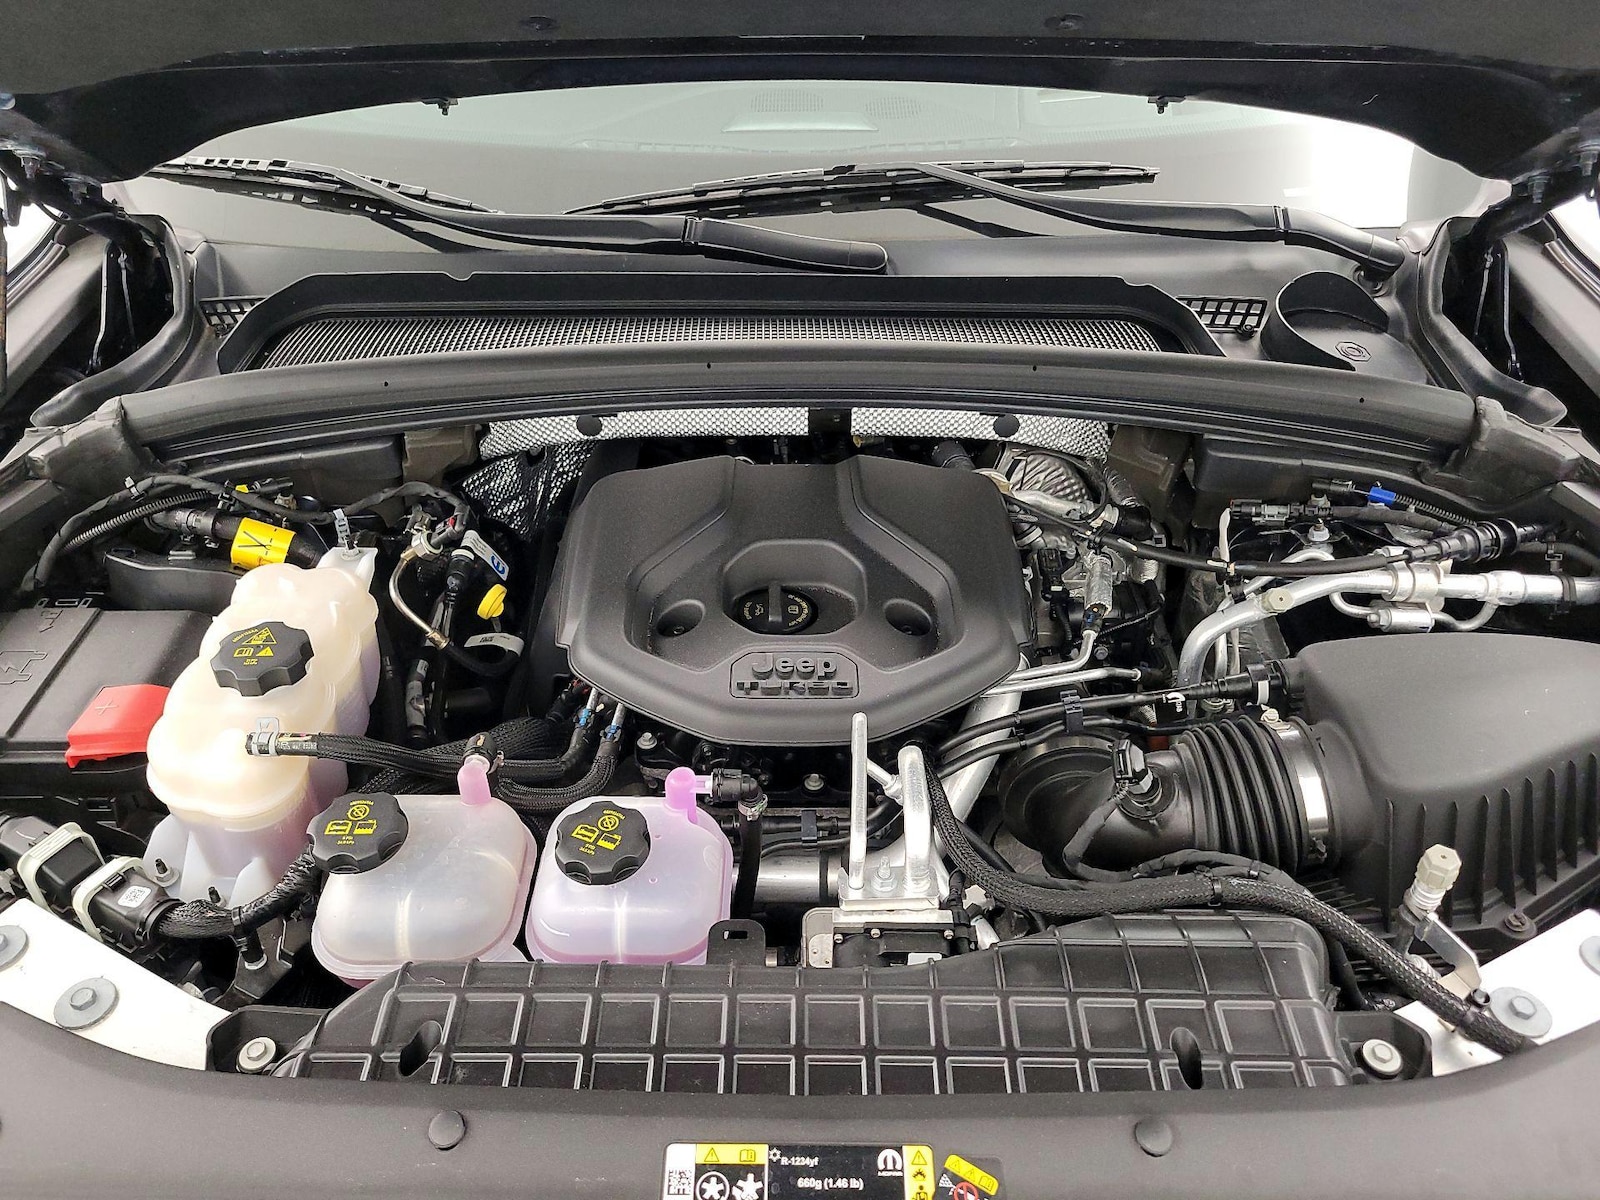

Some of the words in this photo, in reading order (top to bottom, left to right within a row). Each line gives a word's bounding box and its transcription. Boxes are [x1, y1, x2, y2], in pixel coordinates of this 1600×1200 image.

[751, 653, 837, 680] Jeep
[780, 1156, 820, 1168] R-1234yf
[797, 1177, 822, 1190] 660g
[824, 1177, 848, 1191] (1.46
[849, 1177, 864, 1191] lb)
